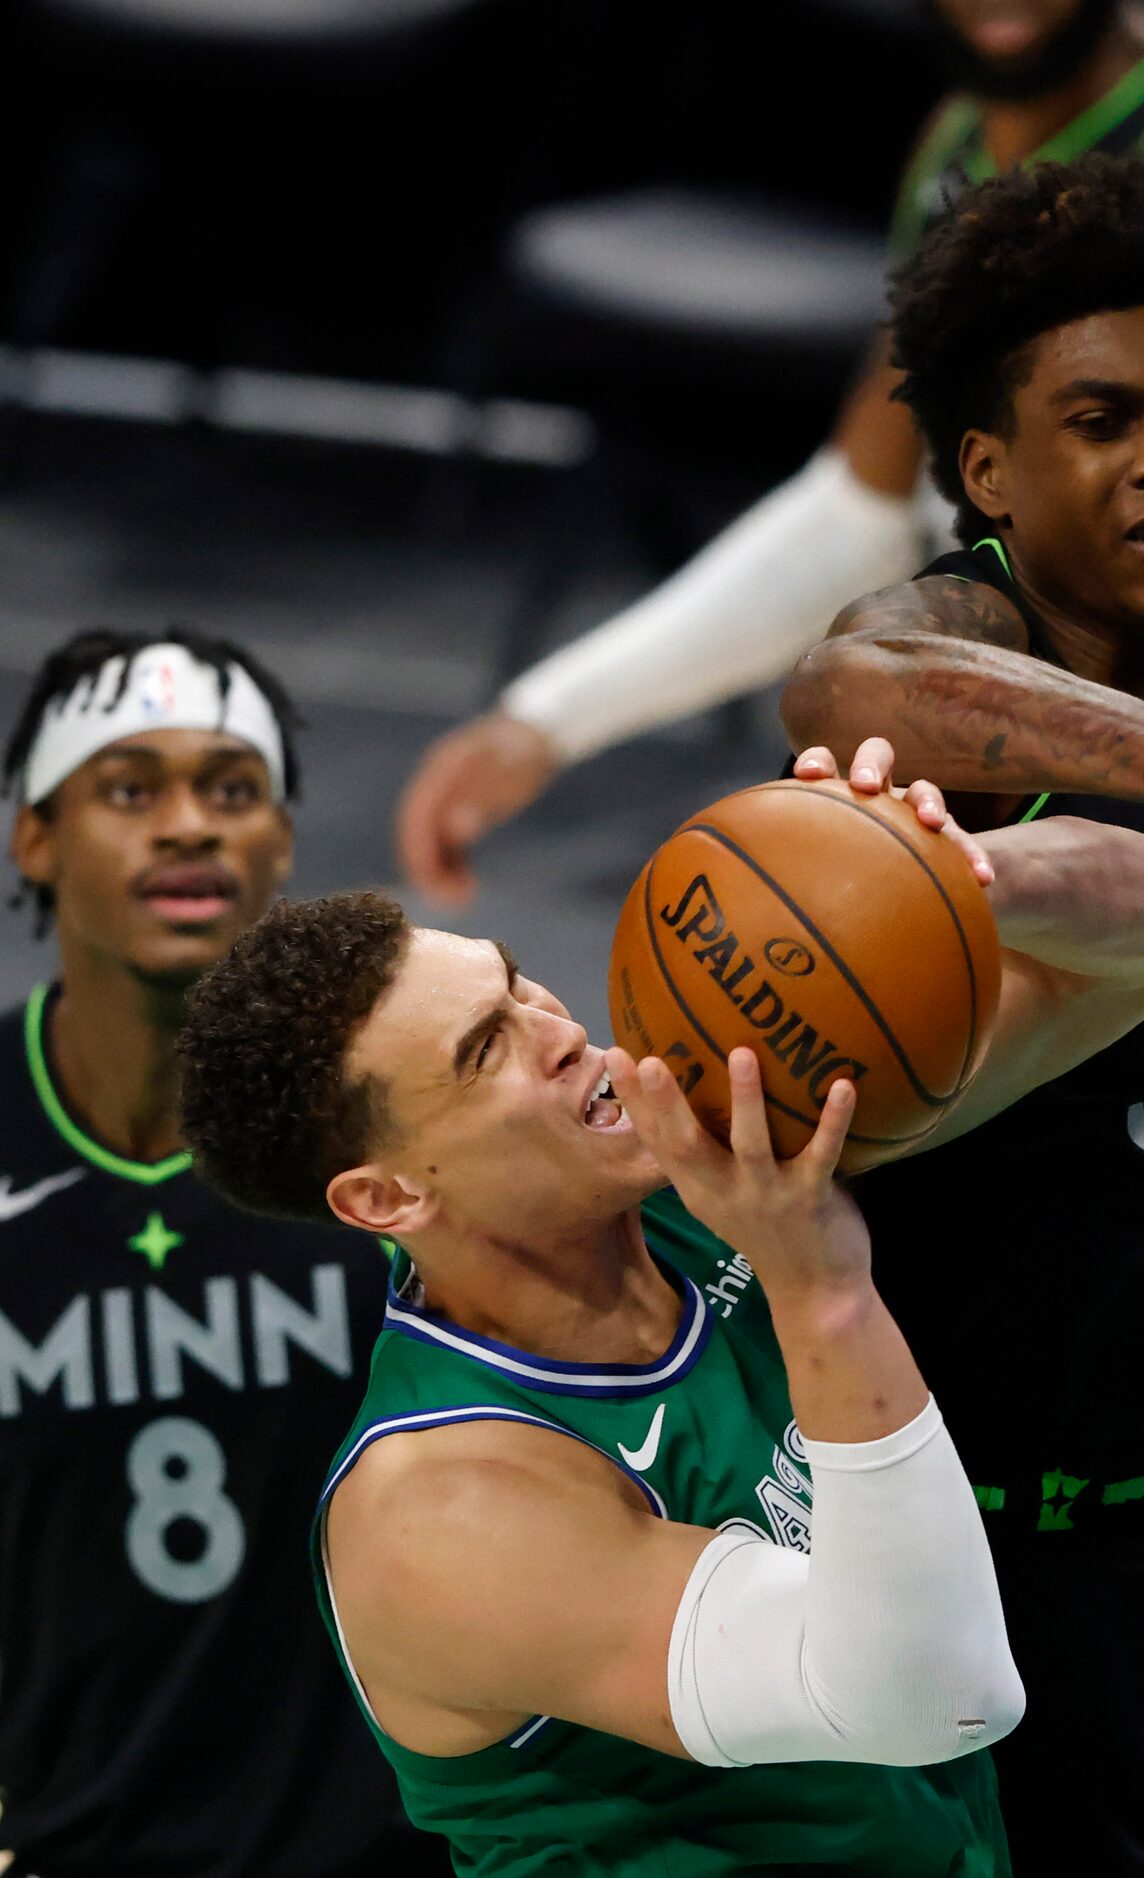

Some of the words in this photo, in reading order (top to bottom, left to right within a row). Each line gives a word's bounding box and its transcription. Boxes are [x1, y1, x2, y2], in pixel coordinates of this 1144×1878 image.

[659, 873, 869, 1111] SPALDING
[0, 1262, 353, 1419] MINN
[125, 1414, 247, 1604] 8
